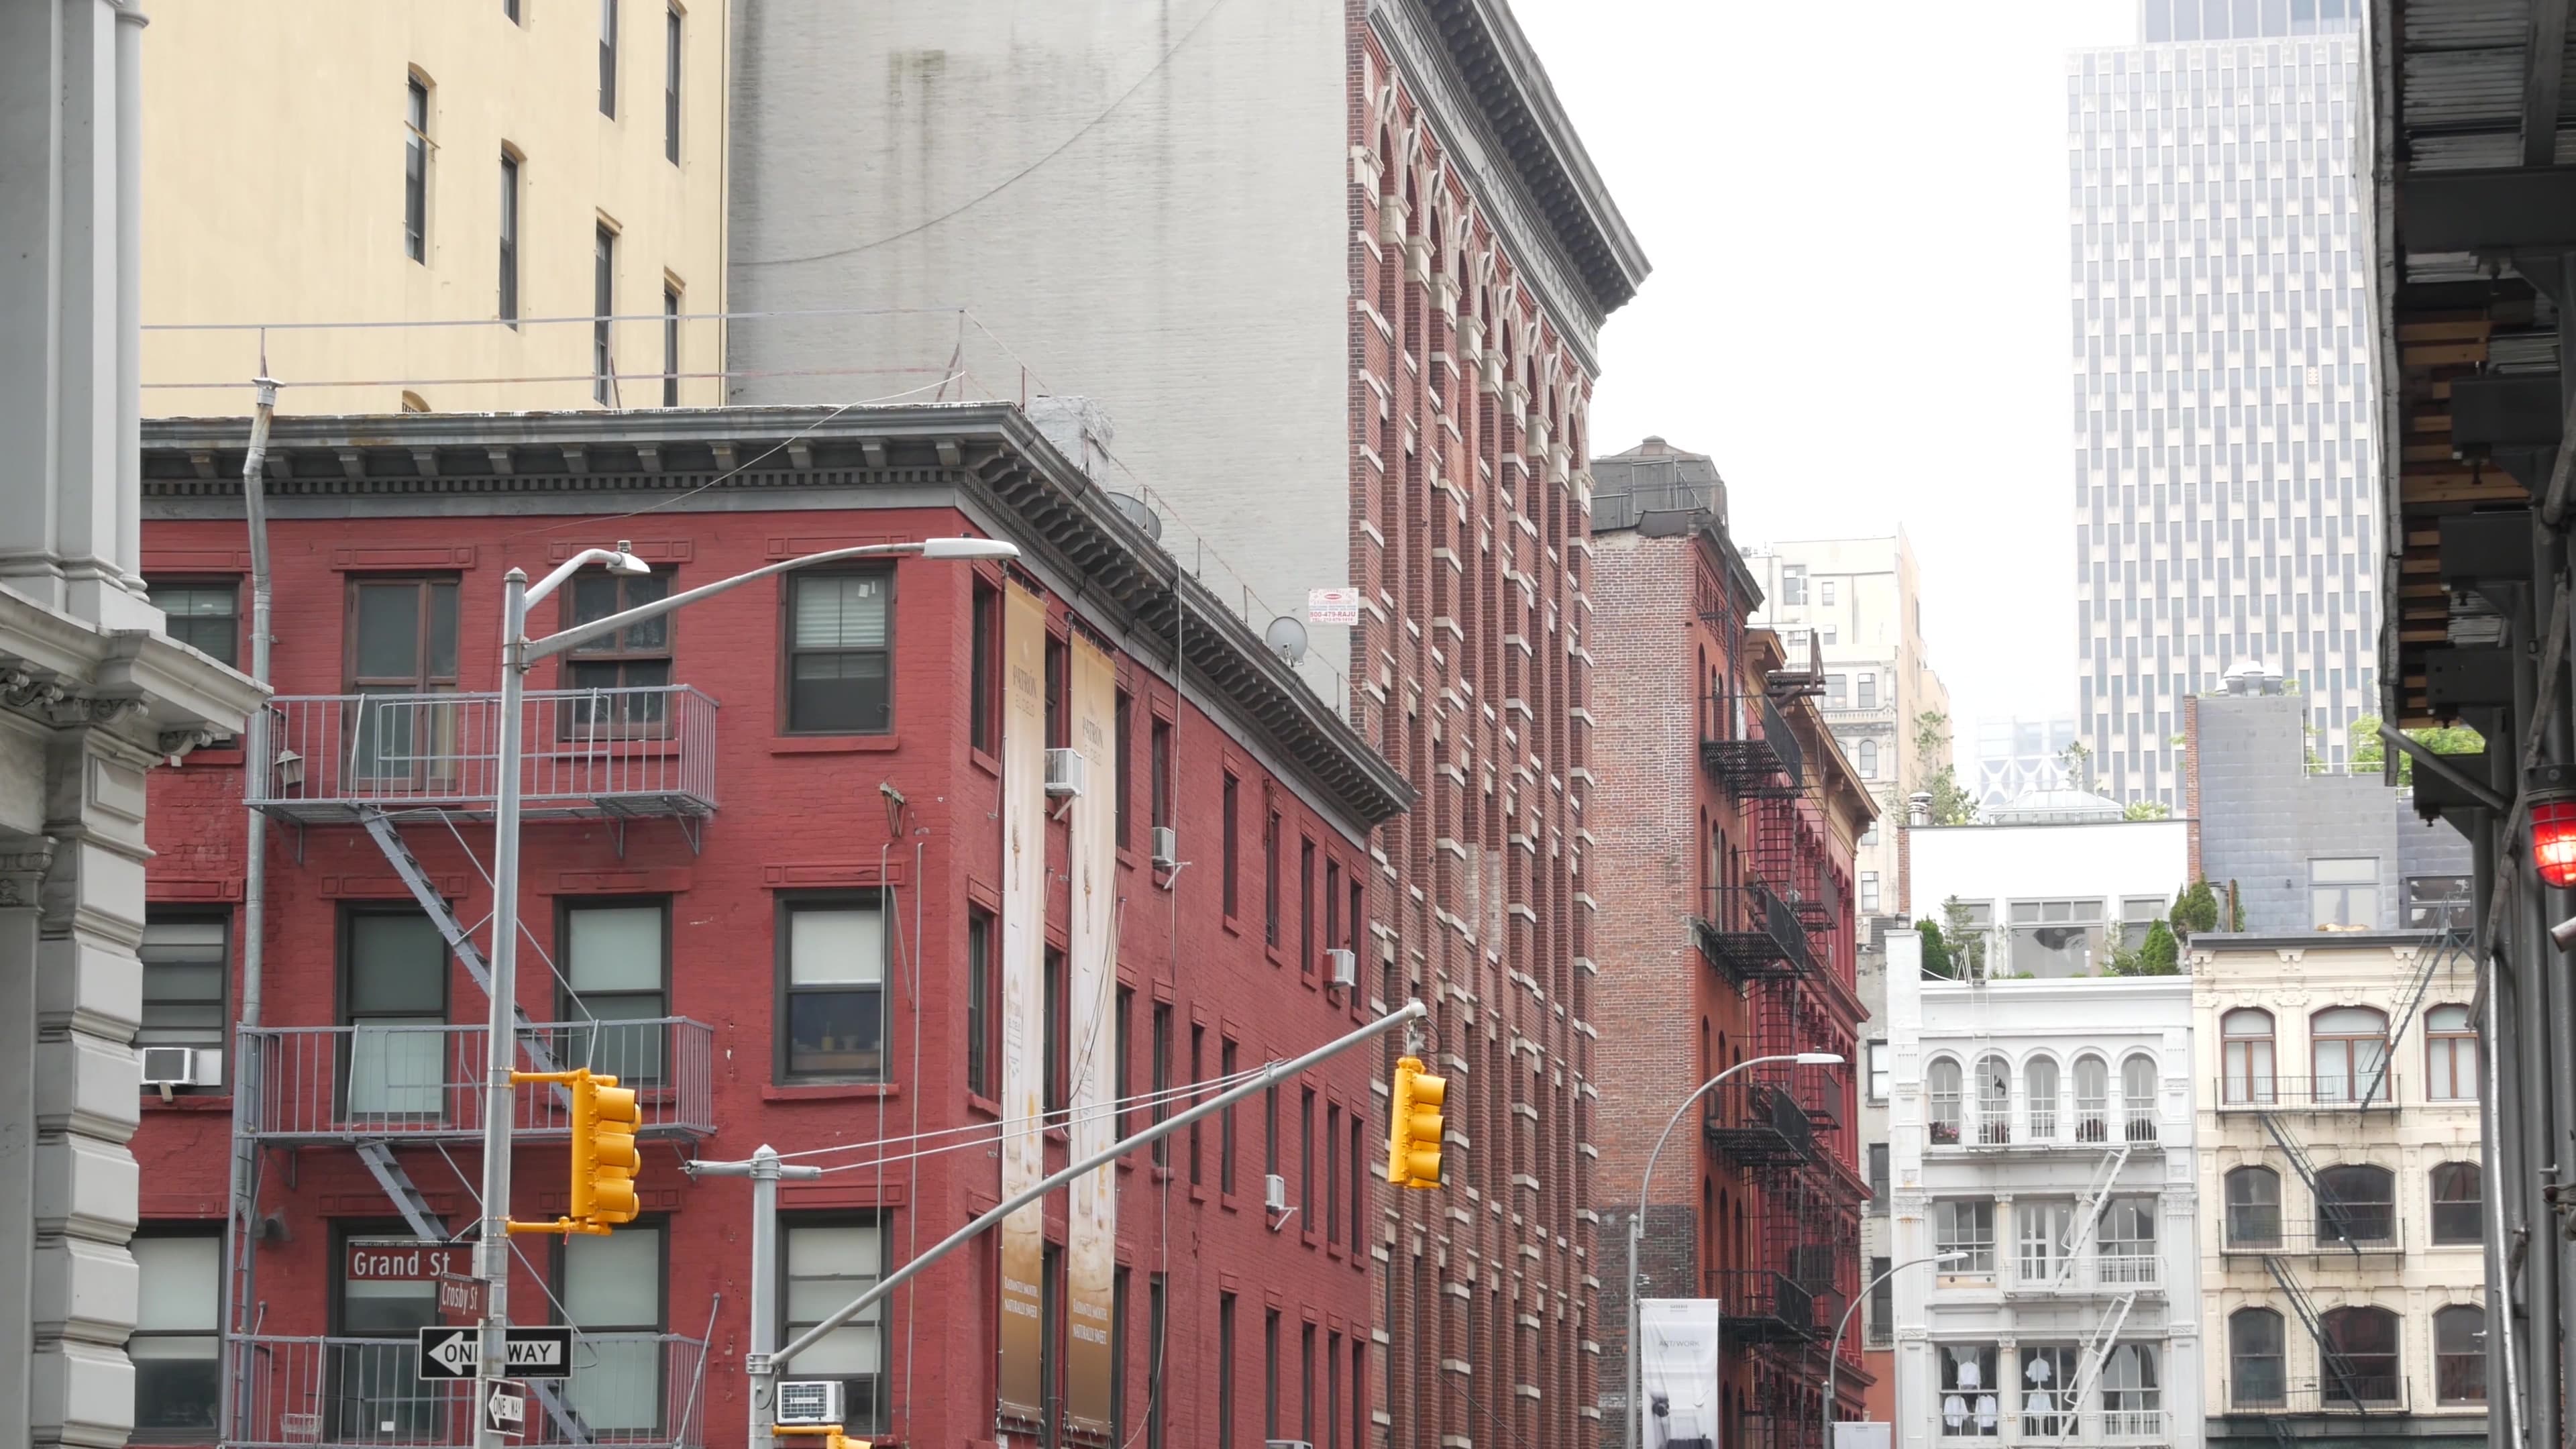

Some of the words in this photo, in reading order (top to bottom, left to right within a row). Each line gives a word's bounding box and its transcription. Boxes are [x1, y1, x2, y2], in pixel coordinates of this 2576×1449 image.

[354, 1250, 419, 1276] Grand
[429, 1252, 450, 1277] St
[441, 1282, 468, 1314] Crosby
[470, 1287, 478, 1310] St
[508, 1344, 552, 1362] WAY
[494, 1397, 506, 1416] ONE
[511, 1399, 522, 1417] WAY
